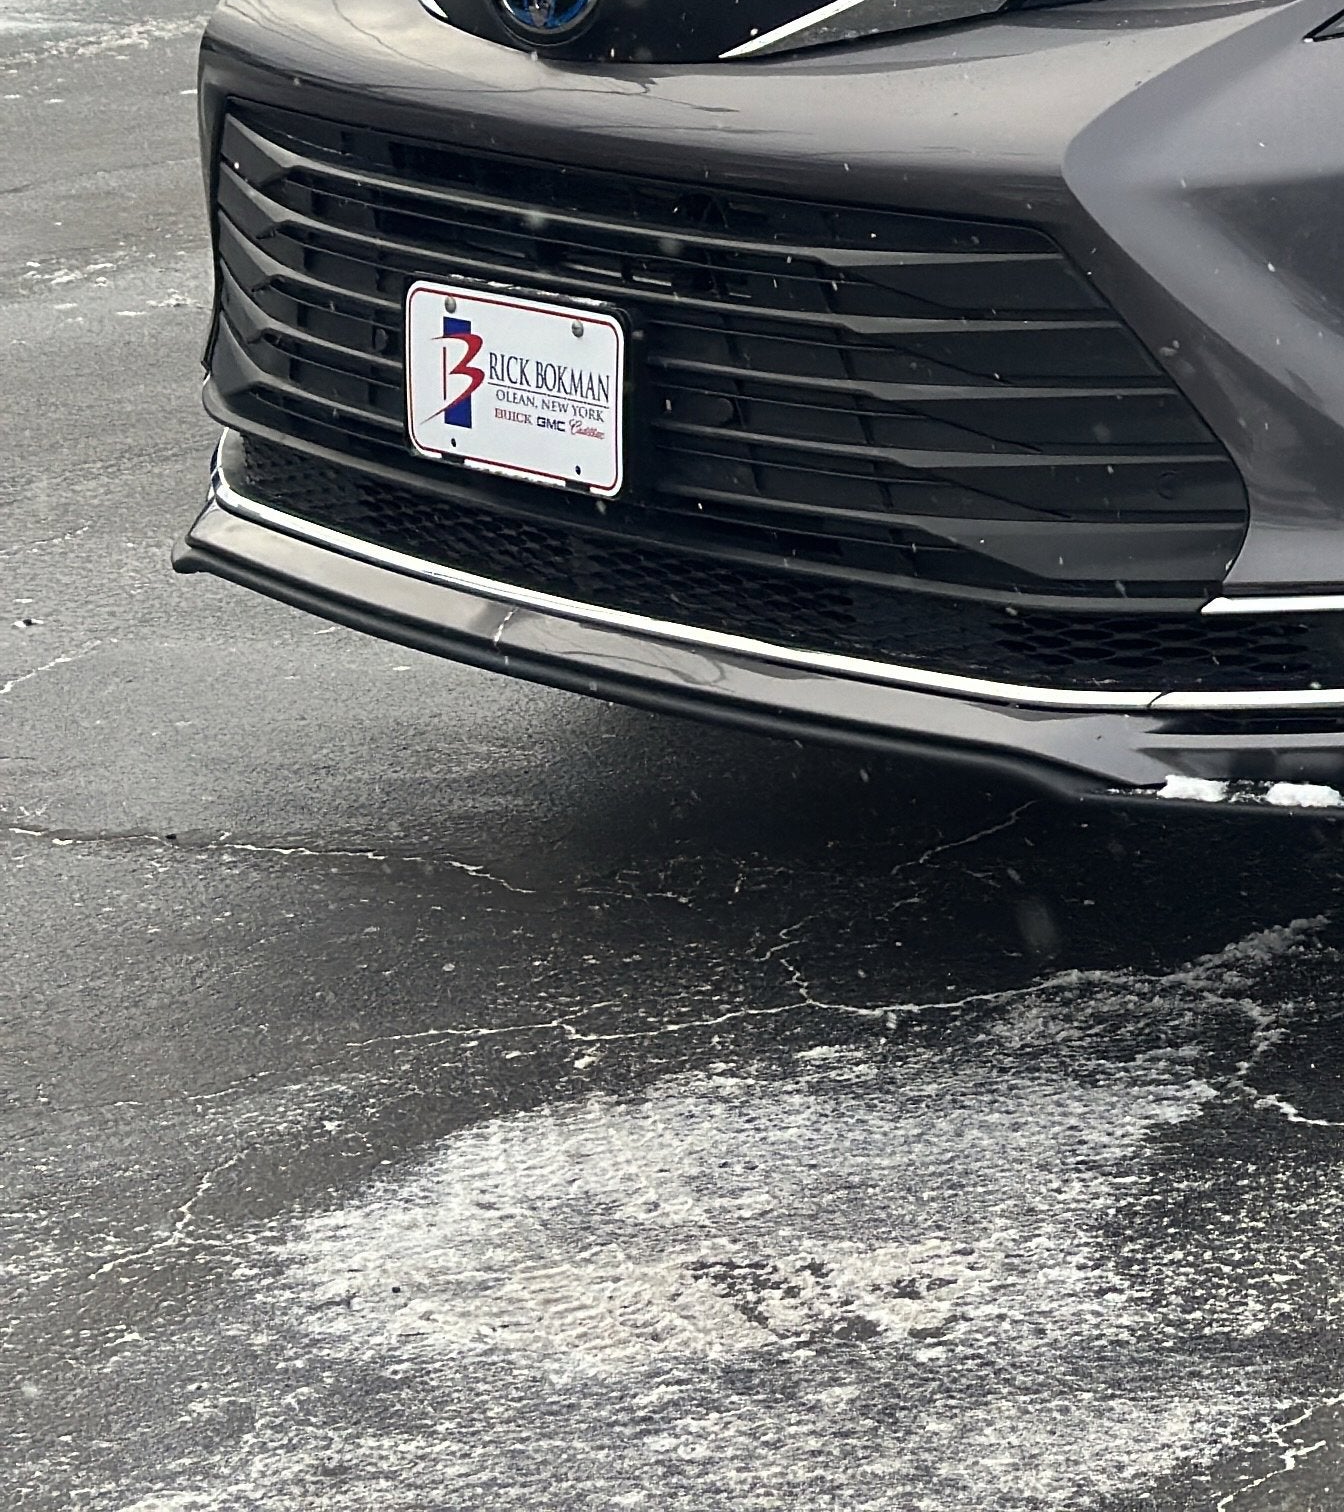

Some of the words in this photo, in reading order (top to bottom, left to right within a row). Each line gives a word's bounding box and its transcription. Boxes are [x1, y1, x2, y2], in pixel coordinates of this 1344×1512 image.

[489, 352, 531, 387] RICK
[535, 360, 610, 403] BOKMAN
[494, 407, 533, 425] BUICK
[536, 416, 566, 432] GMC
[496, 389, 538, 408] OLEAN,
[541, 399, 569, 413] NEW
[571, 405, 605, 423] YORK
